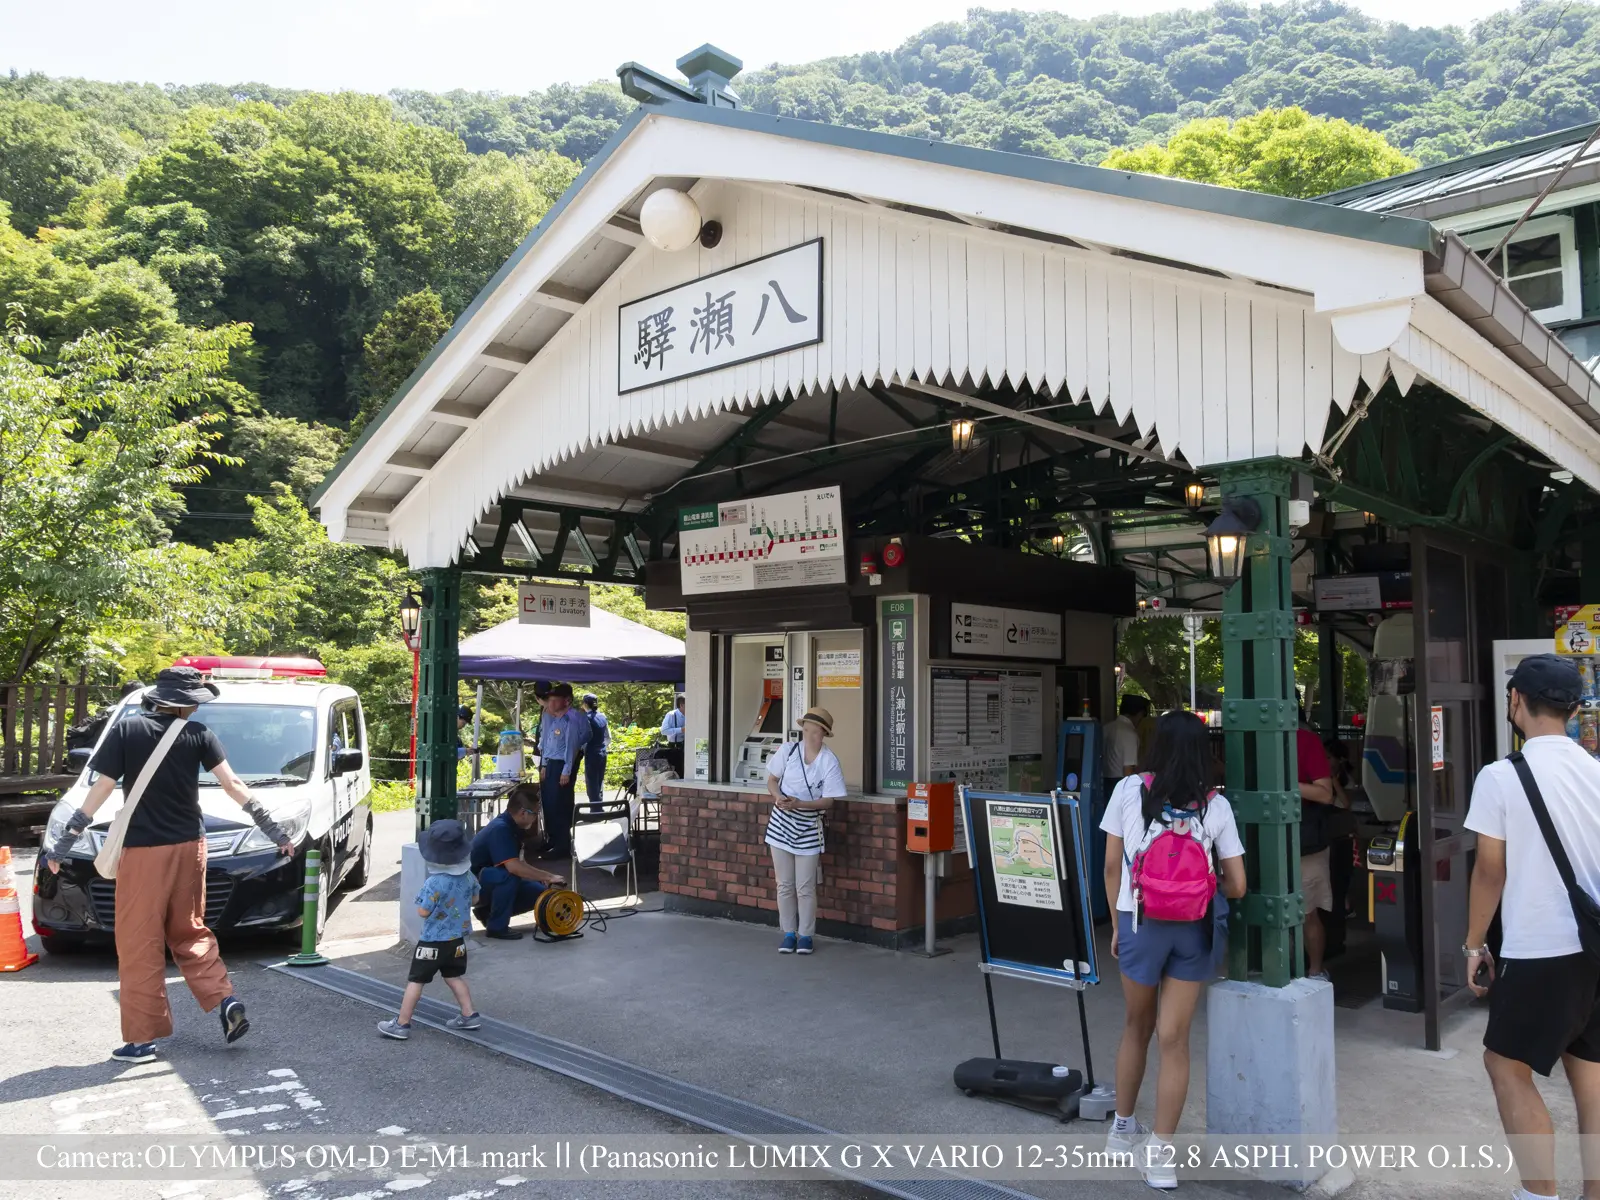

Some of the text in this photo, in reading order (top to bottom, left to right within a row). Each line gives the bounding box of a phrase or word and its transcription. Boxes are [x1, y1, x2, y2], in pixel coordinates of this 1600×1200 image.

[559, 597, 587, 608] お手洗
[890, 604, 905, 612] E08
[559, 607, 586, 616] Lavatory
[896, 641, 906, 772] 叡山電車 八瀬比叡山口駅
[334, 814, 354, 848] POLICE
